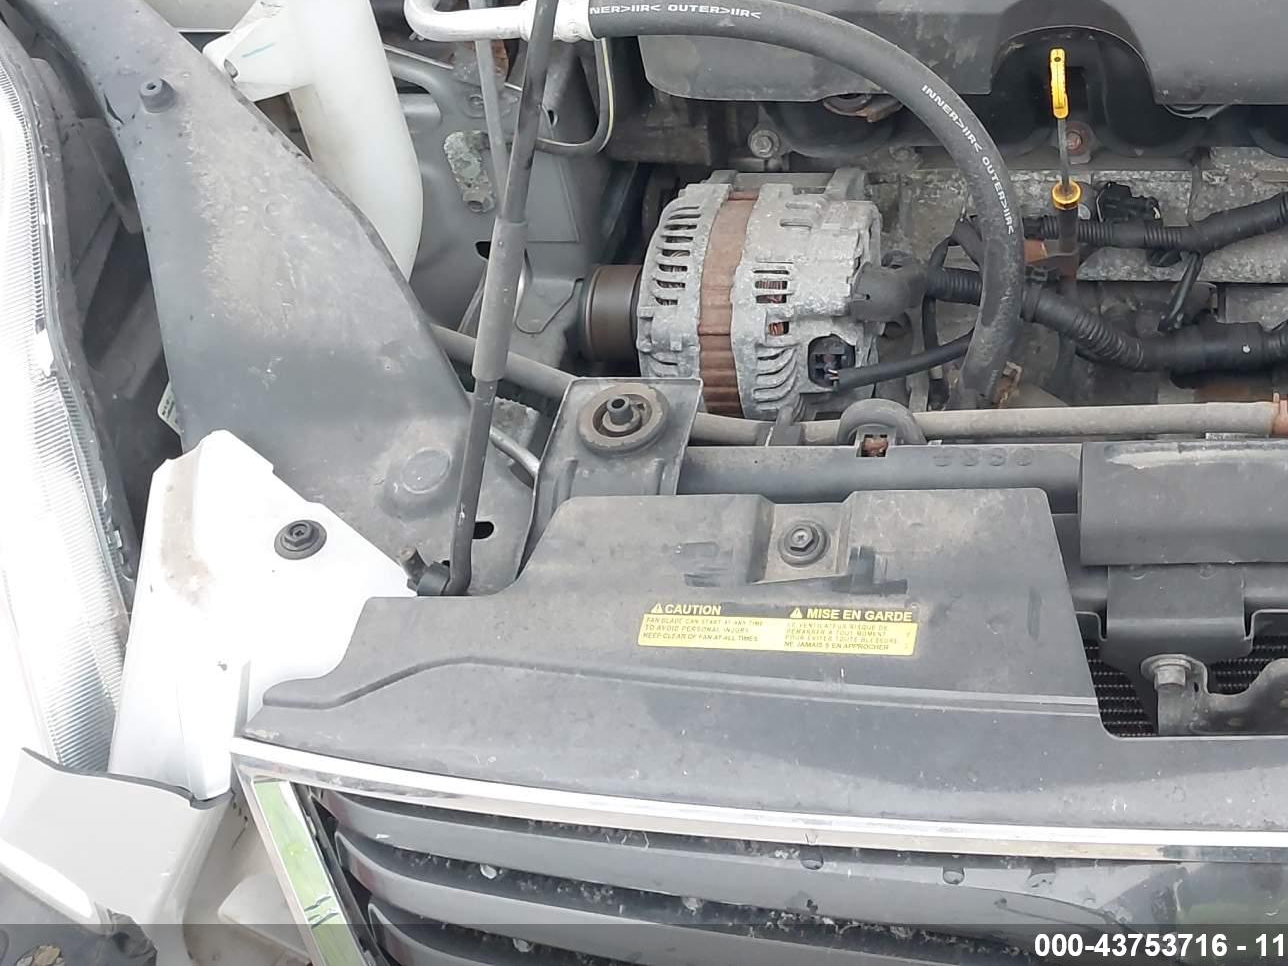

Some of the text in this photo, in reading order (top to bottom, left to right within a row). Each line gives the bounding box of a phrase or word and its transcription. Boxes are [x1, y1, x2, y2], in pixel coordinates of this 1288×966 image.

[667, 4, 763, 19] OUTER>IIR<
[921, 84, 1015, 236] INNER>IIR< OUTER>IIR<
[664, 604, 722, 616] CAUTION
[806, 608, 913, 622] MISE EN GARDE
[783, 640, 794, 648] NE
[797, 641, 823, 649] JAMAIS
[843, 643, 890, 651] APPROCHER
